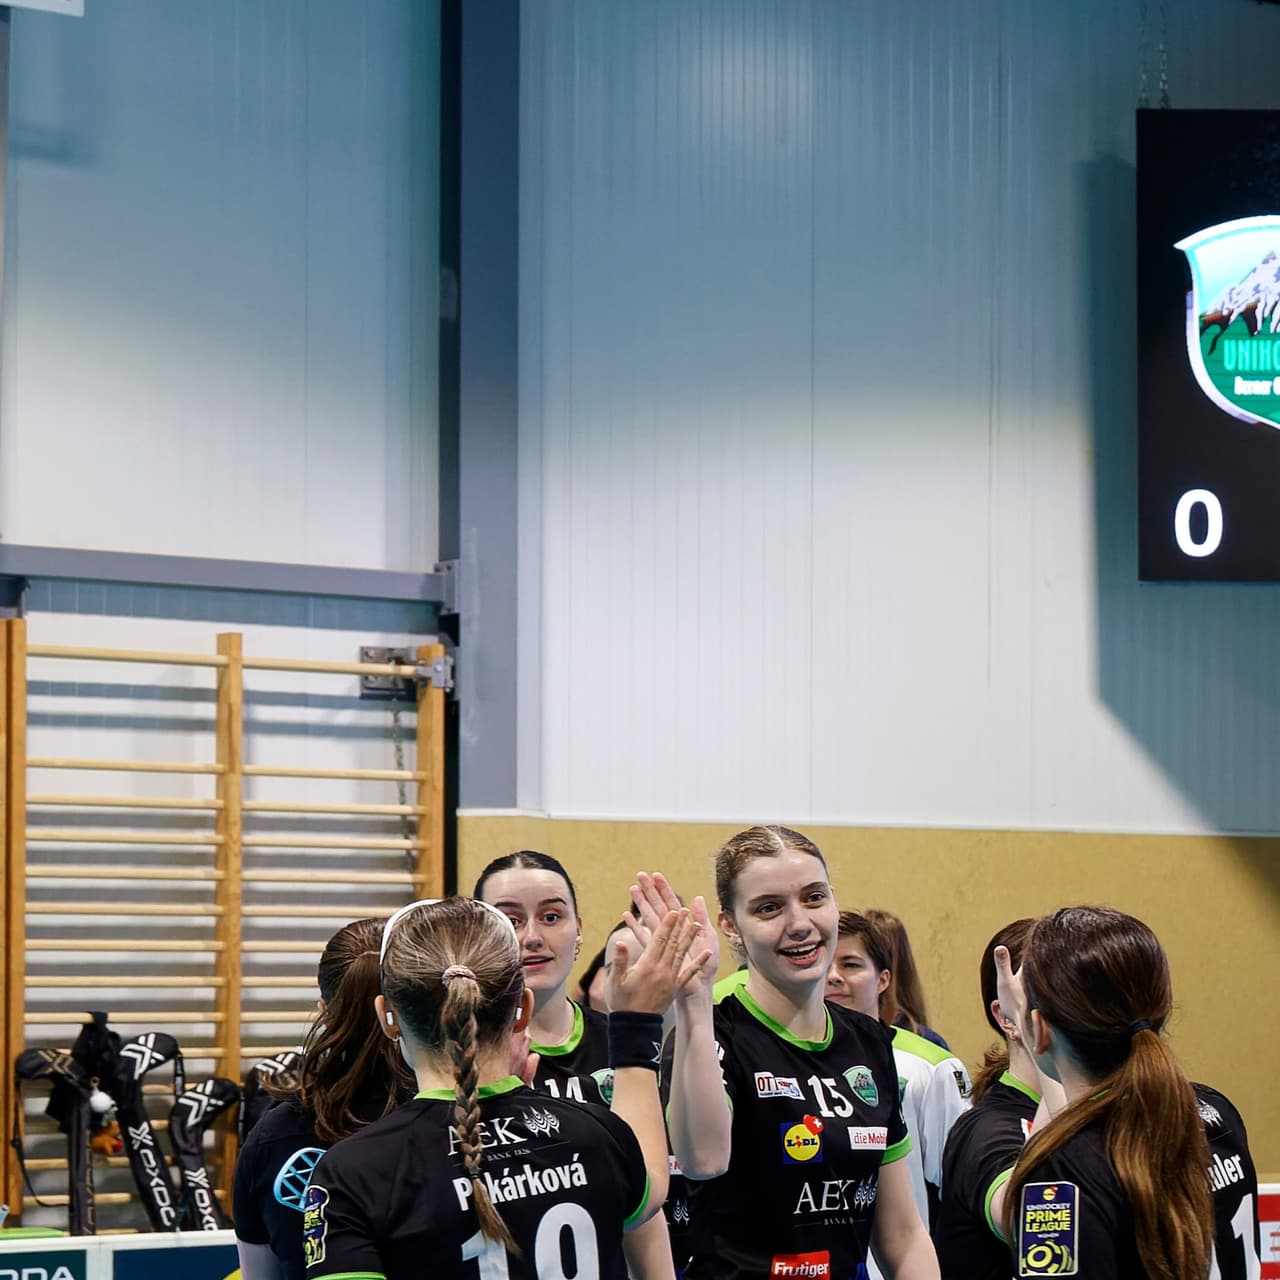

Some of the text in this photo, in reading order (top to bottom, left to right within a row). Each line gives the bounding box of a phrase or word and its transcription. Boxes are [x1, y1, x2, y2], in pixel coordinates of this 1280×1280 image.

[1174, 489, 1224, 556] 0
[807, 1075, 854, 1118] 15
[452, 1153, 588, 1211] Pkárková
[1025, 1221, 1071, 1232] LEAGUE
[1026, 1209, 1071, 1222] PRIME
[774, 1262, 828, 1278] Frutiger
